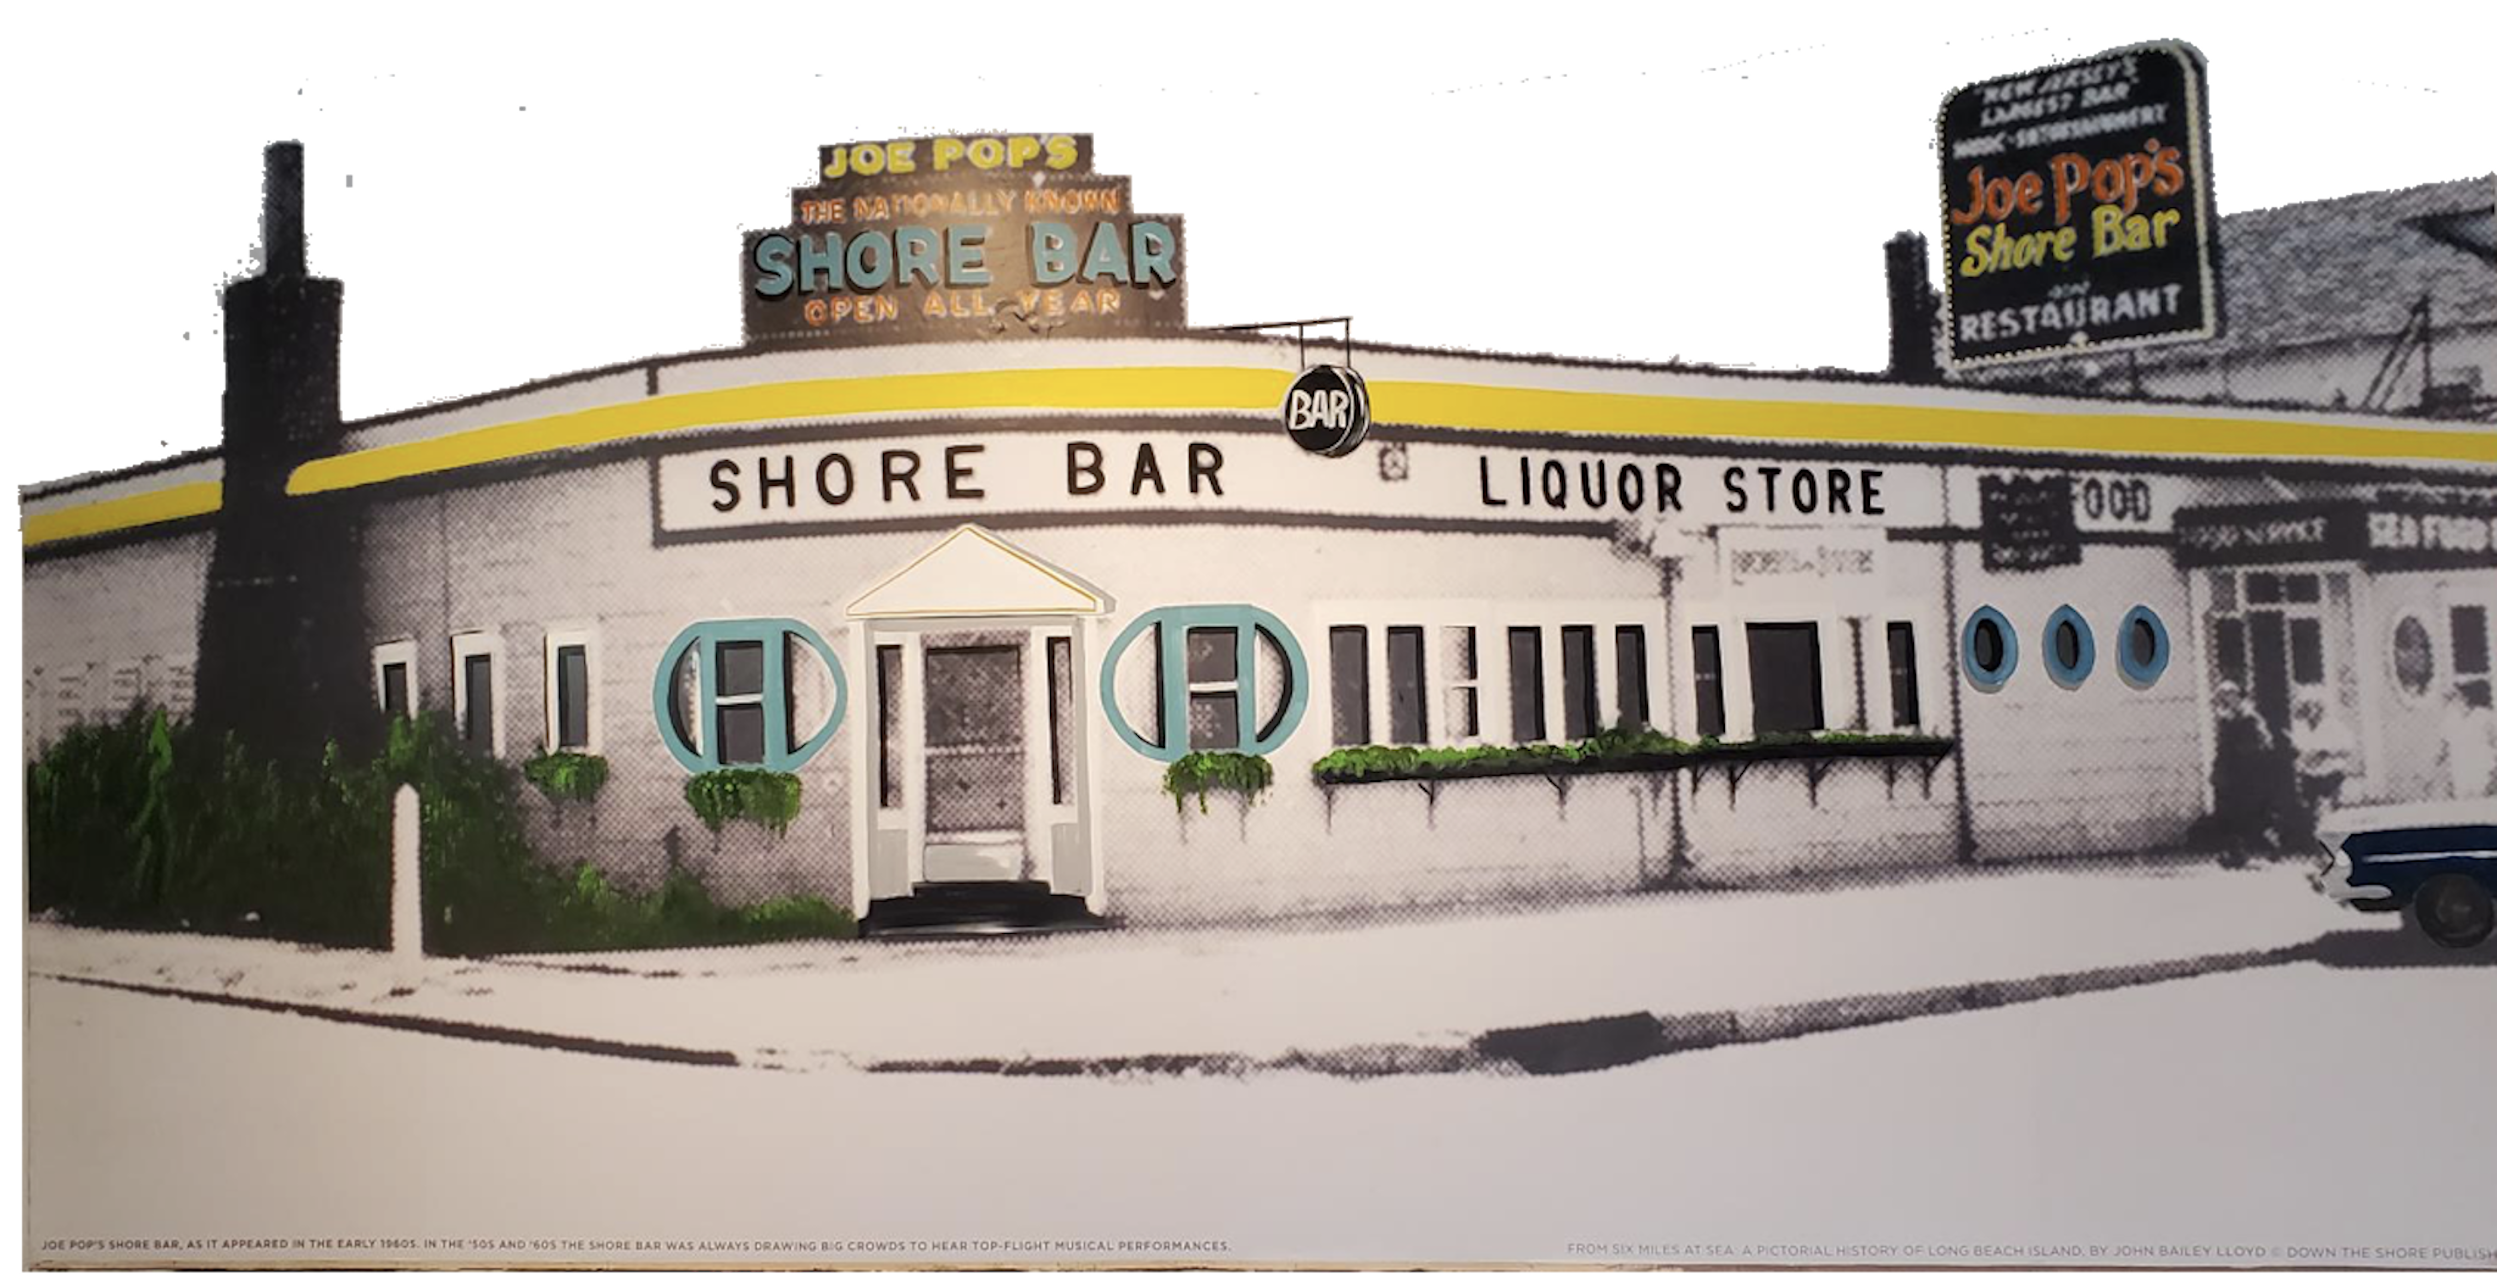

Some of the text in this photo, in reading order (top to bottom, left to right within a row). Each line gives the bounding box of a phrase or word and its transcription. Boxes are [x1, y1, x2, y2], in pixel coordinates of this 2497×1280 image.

[824, 135, 1078, 178] JOE POP'S
[1952, 138, 2184, 224] Joe Pop's
[802, 189, 1120, 224] THE NATIONALLY KNOWN
[755, 221, 1178, 298] SHORE BAR
[1959, 204, 2181, 277] Shore Bar
[804, 289, 1121, 326] OPEN ALL YEAR
[1960, 284, 2182, 342] RESTAURANT
[1288, 389, 1350, 430] BAR
[709, 441, 1225, 512] SHORE BAR
[1480, 456, 1886, 514] LIQUOR STORE
